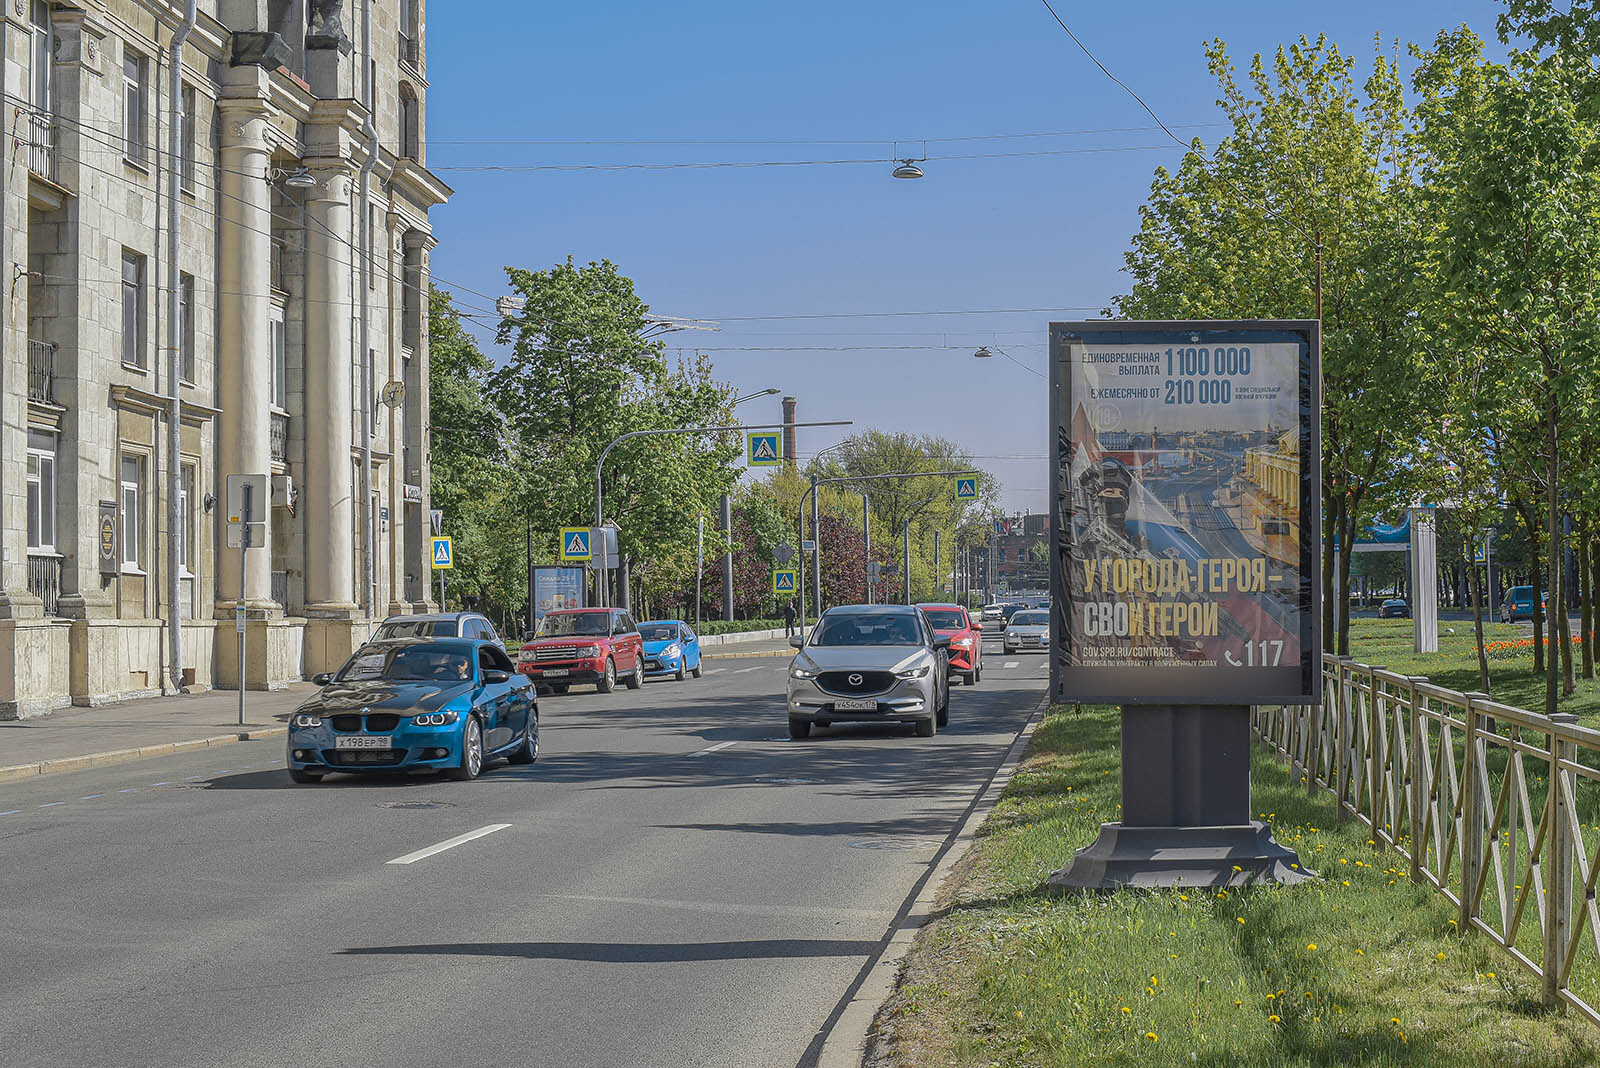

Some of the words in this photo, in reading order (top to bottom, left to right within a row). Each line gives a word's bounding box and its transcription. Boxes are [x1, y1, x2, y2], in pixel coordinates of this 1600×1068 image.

[1081, 352, 1160, 363] ЕДИНОВРЕМЕННАЯ
[1119, 365, 1160, 375] ВЫПЛАТА
[1177, 348, 1209, 376] 100
[1214, 347, 1251, 376] 000
[1090, 388, 1148, 399] ЕЖЕМЕСЯЧНО
[1150, 388, 1160, 399] ОТ
[1164, 379, 1194, 405] 210
[1199, 379, 1231, 405] 000
[1084, 559, 1097, 593] У
[1101, 558, 1266, 597] ГОРОДА-ГЕРОЯ
[1084, 602, 1144, 636] СВОИ
[1149, 602, 1218, 636] ГЕРОИ
[1083, 646, 1175, 657] GOV.SPB.RU/CONTRACT
[1244, 640, 1284, 667] 117
